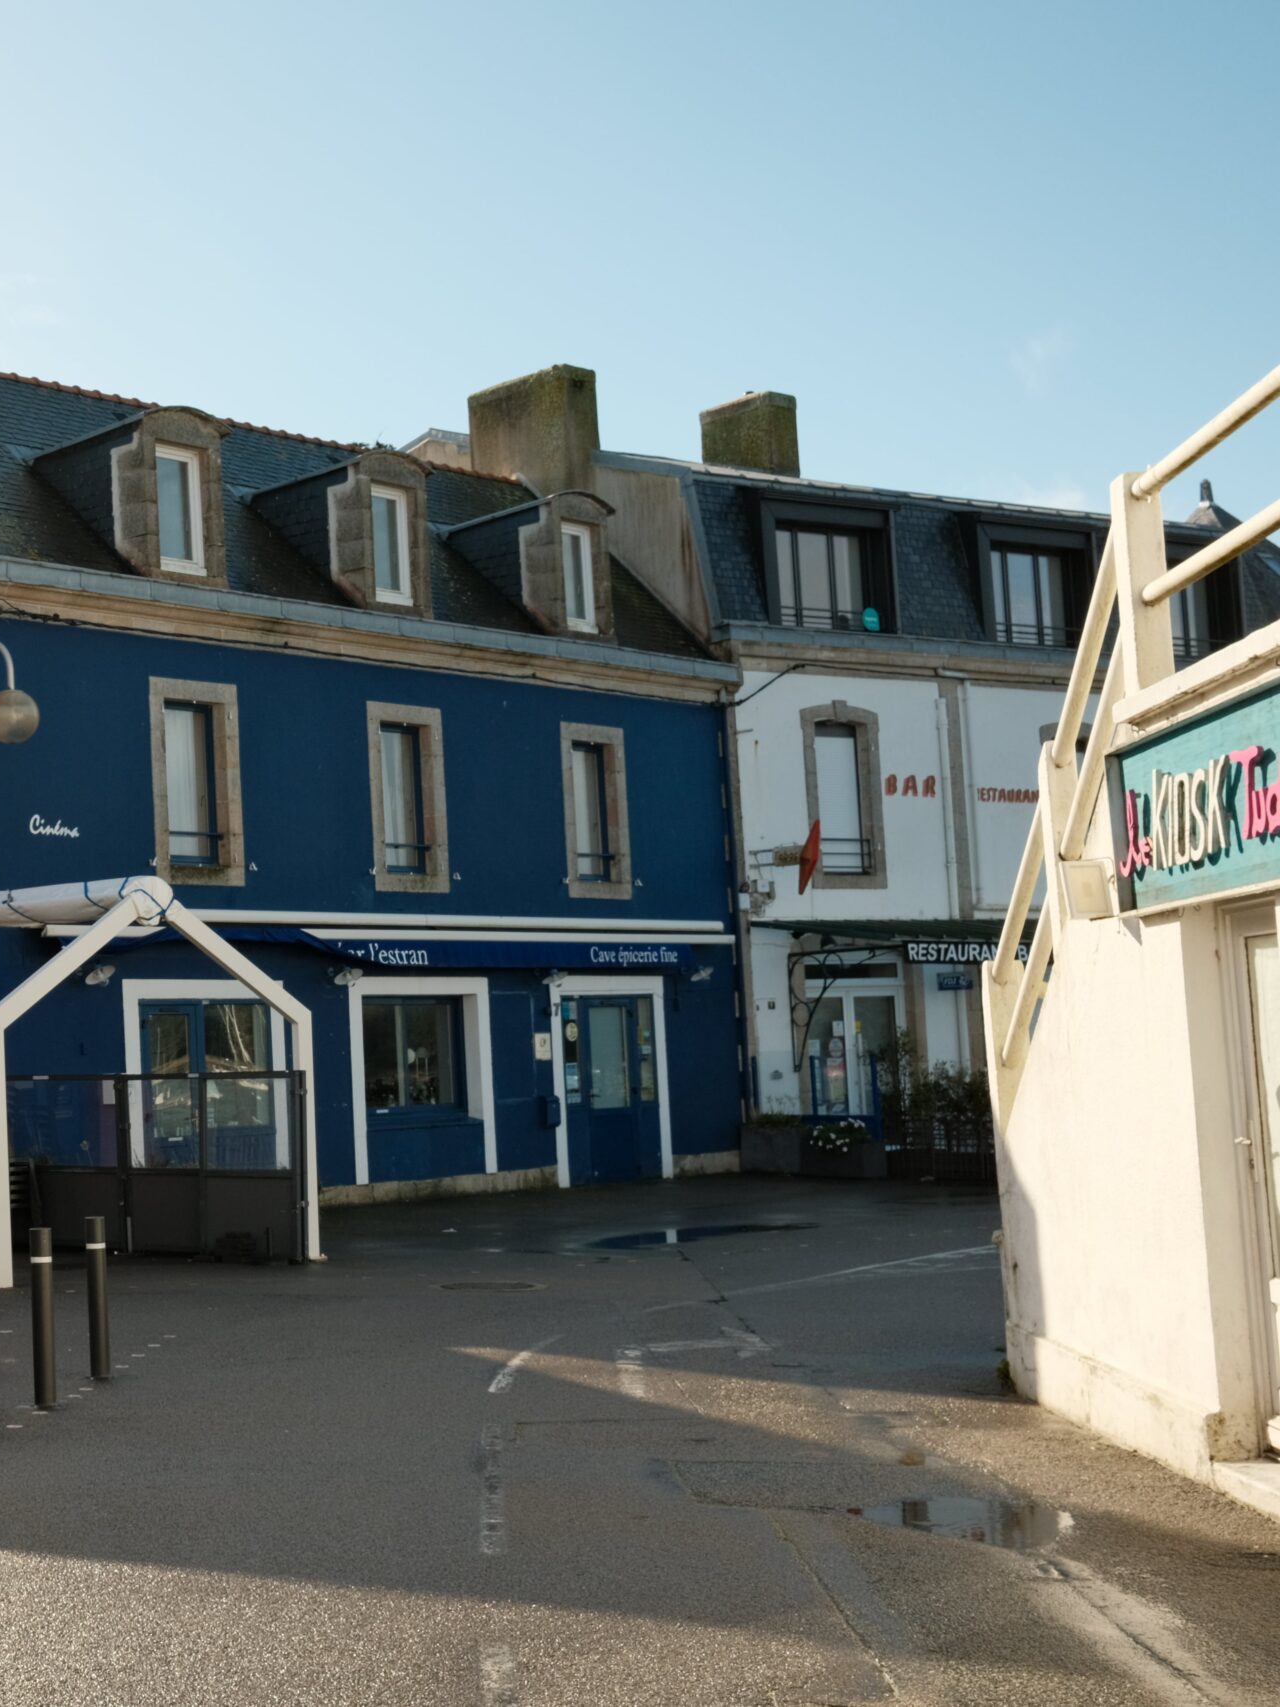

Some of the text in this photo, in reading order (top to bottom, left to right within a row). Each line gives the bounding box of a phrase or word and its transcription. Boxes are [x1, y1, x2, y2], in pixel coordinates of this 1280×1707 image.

[884, 773, 937, 798] BAR
[1152, 754, 1228, 872] KIOSK
[590, 945, 679, 967] Cave épicerie fine
